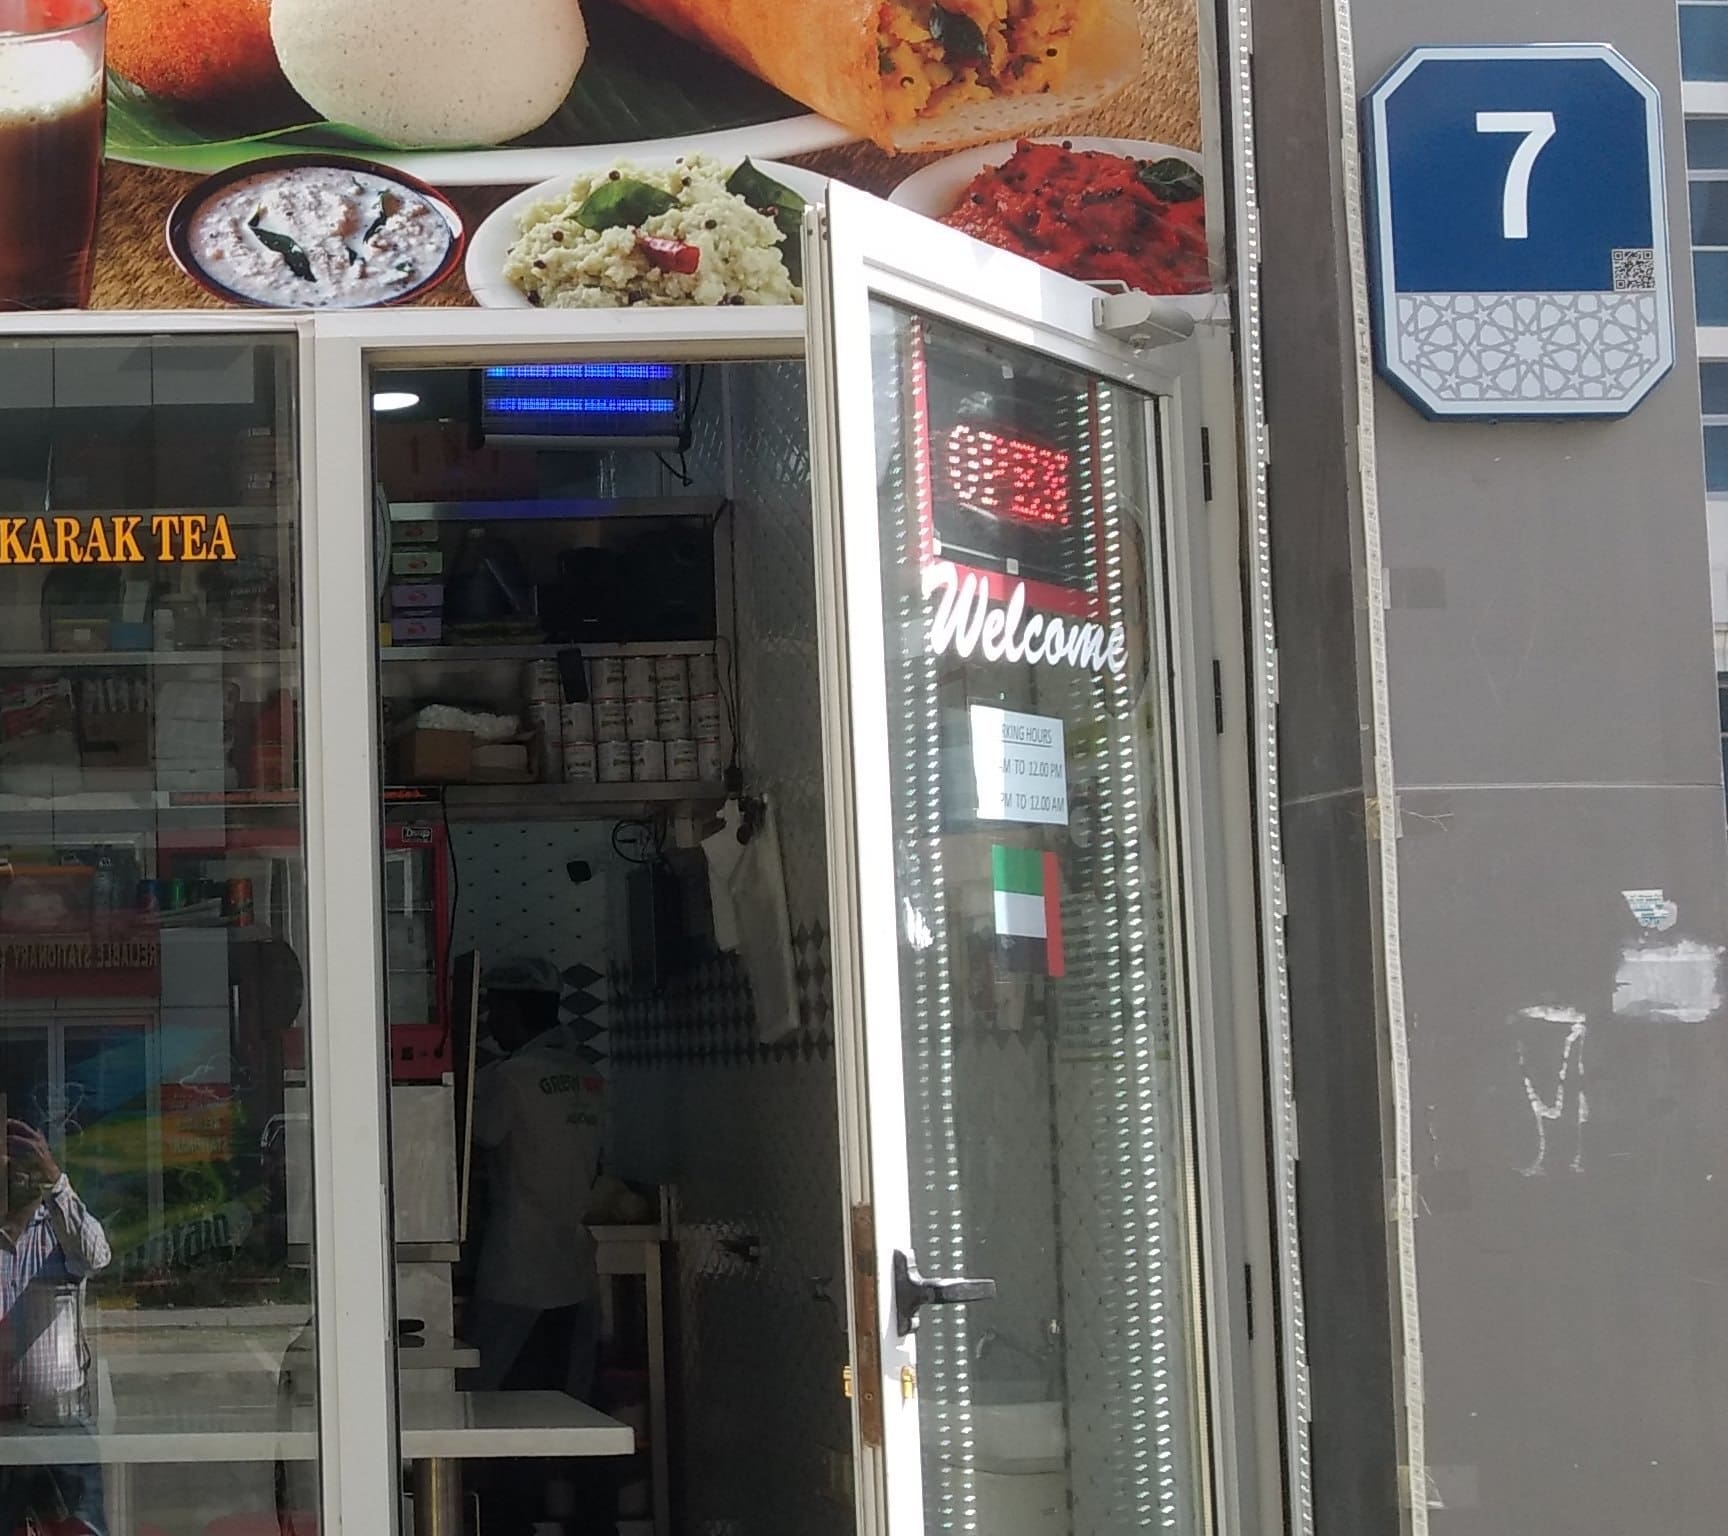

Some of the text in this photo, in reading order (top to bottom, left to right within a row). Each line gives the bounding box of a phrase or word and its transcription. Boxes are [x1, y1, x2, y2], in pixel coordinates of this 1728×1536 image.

[1475, 111, 1557, 239] 7
[948, 424, 1070, 524] OPEN
[151, 513, 237, 562] TEA
[920, 560, 1129, 675] Welcome
[1025, 727, 1052, 745] HOURS
[1013, 758, 1025, 776] TO
[1049, 762, 1063, 779] PM
[1014, 792, 1026, 808] TO
[1050, 795, 1064, 811] AM
